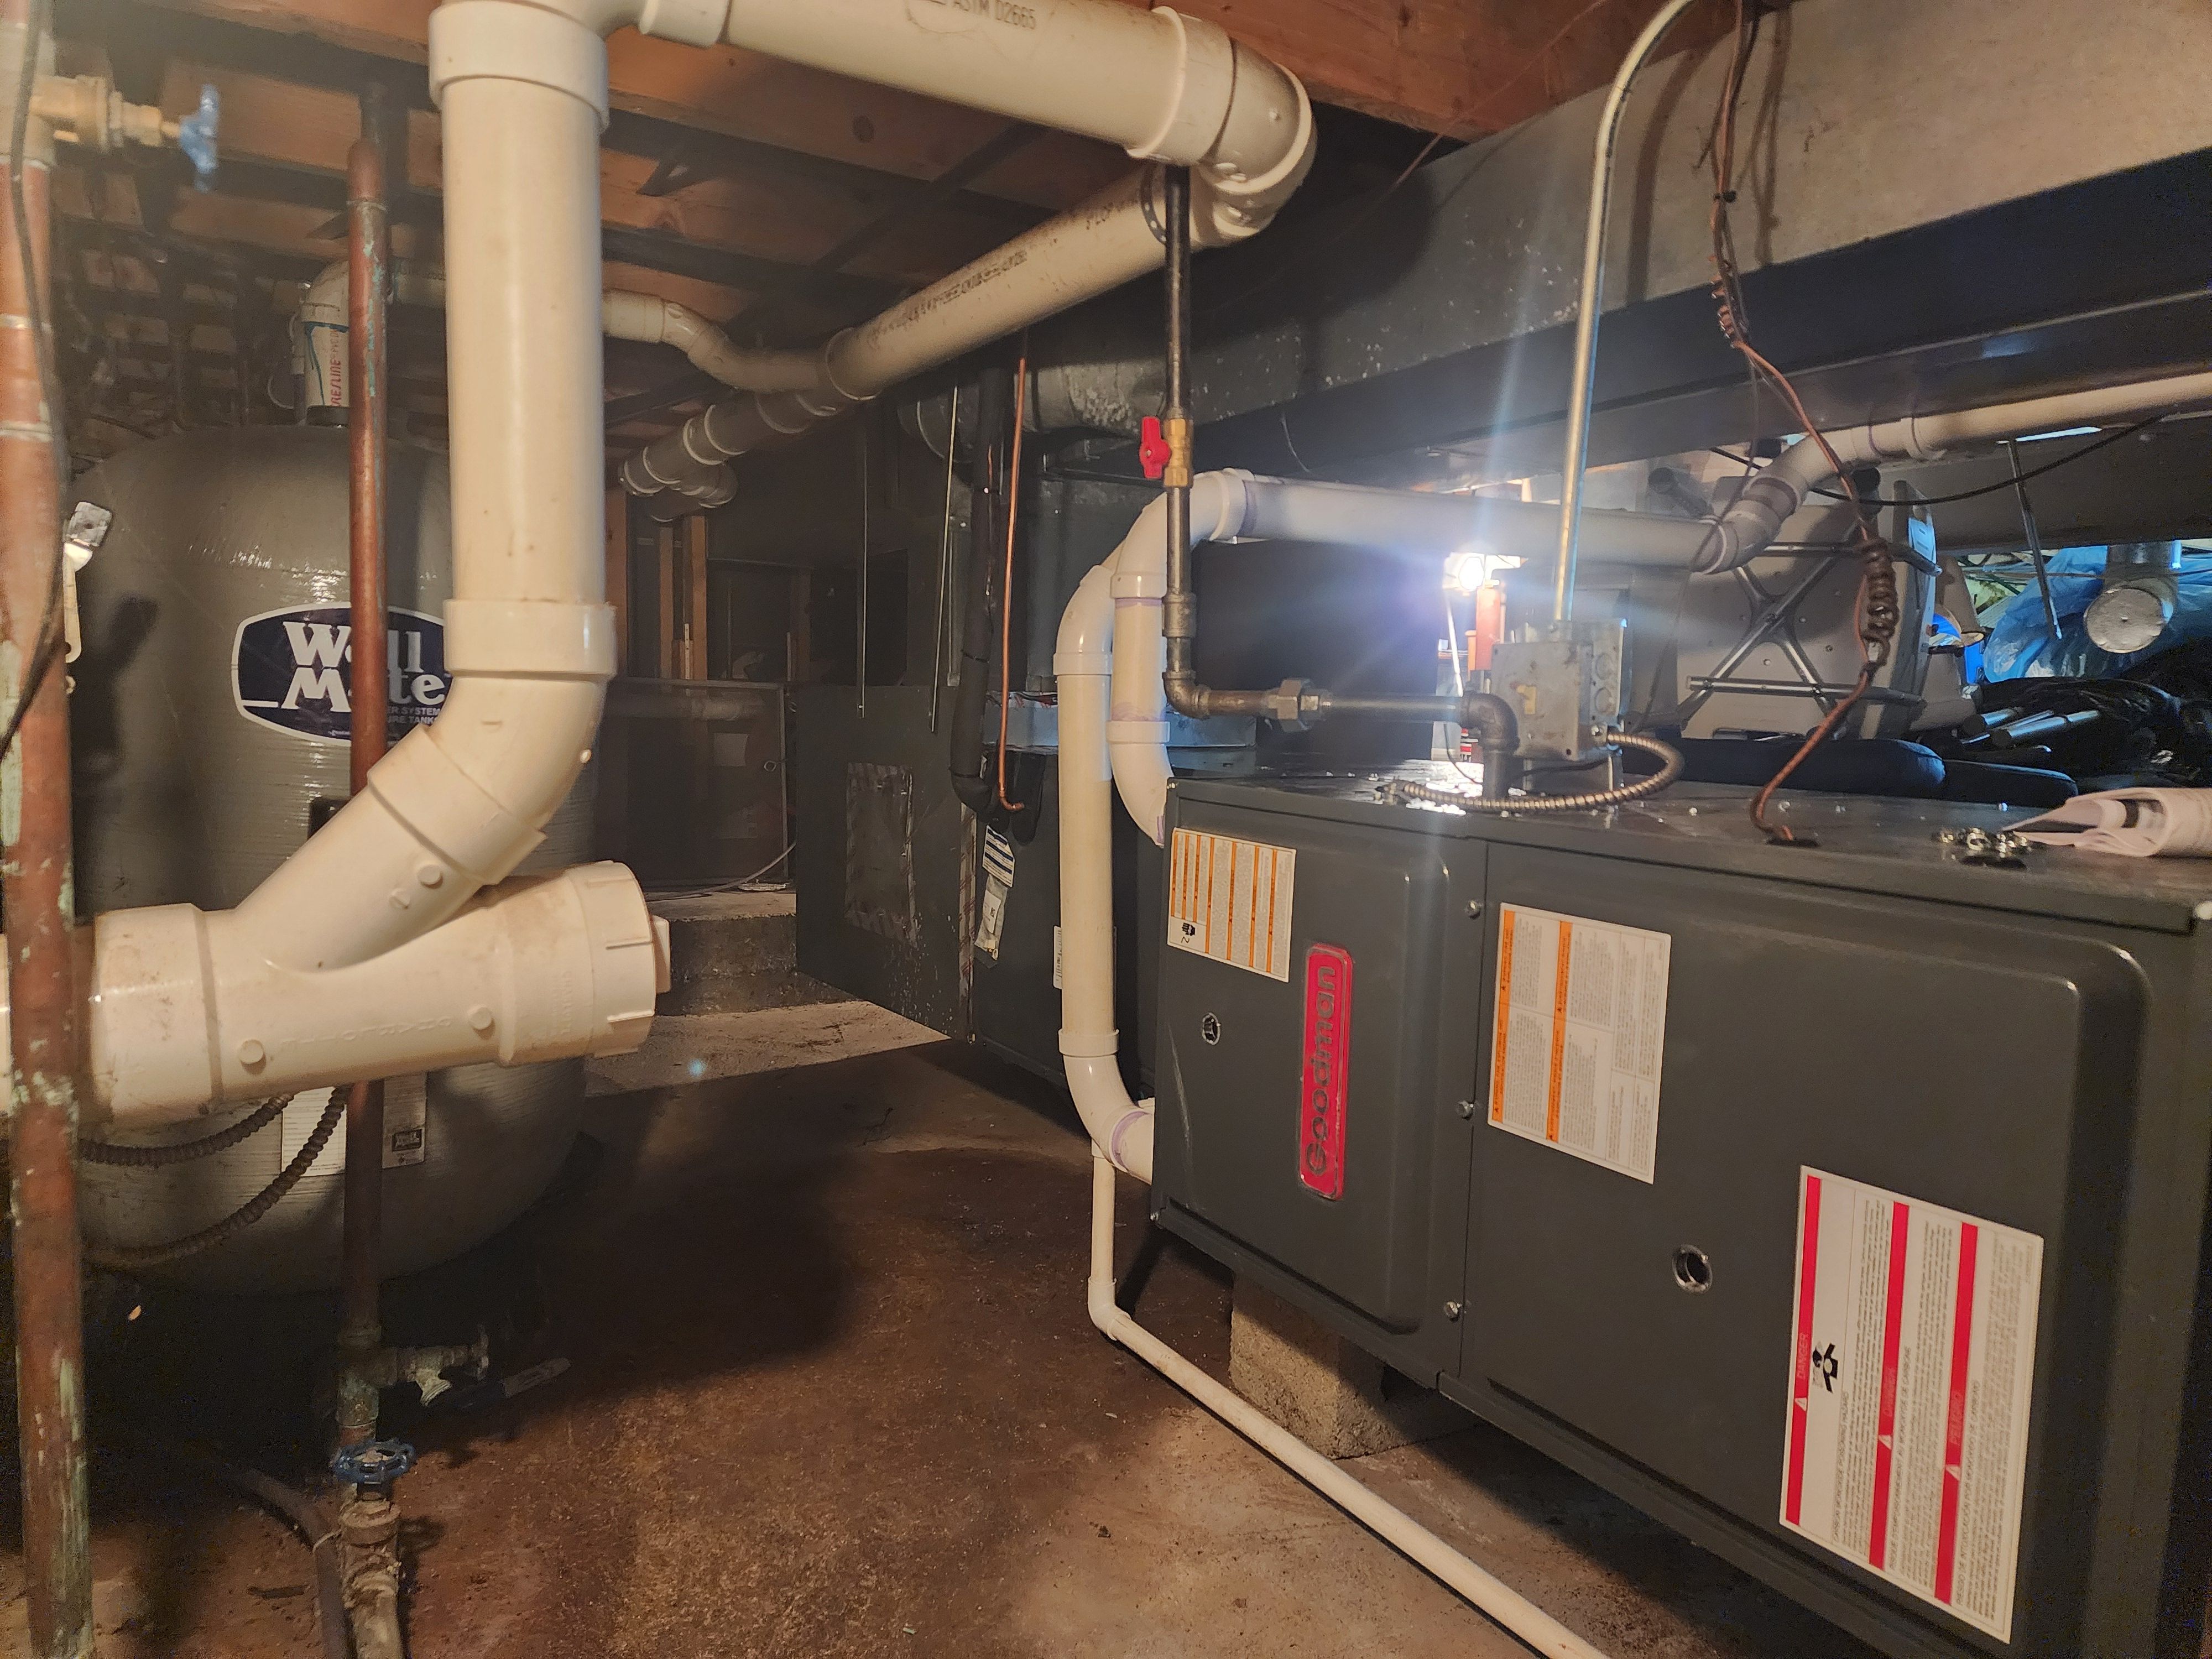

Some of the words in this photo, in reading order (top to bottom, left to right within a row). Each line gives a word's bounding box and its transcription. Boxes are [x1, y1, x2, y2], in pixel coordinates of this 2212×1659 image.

[995, 0, 1036, 30] D2665
[283, 622, 424, 673] Wll
[281, 667, 445, 713] Mte
[409, 715, 437, 725] TANK
[1306, 966, 1335, 1177] Goodman
